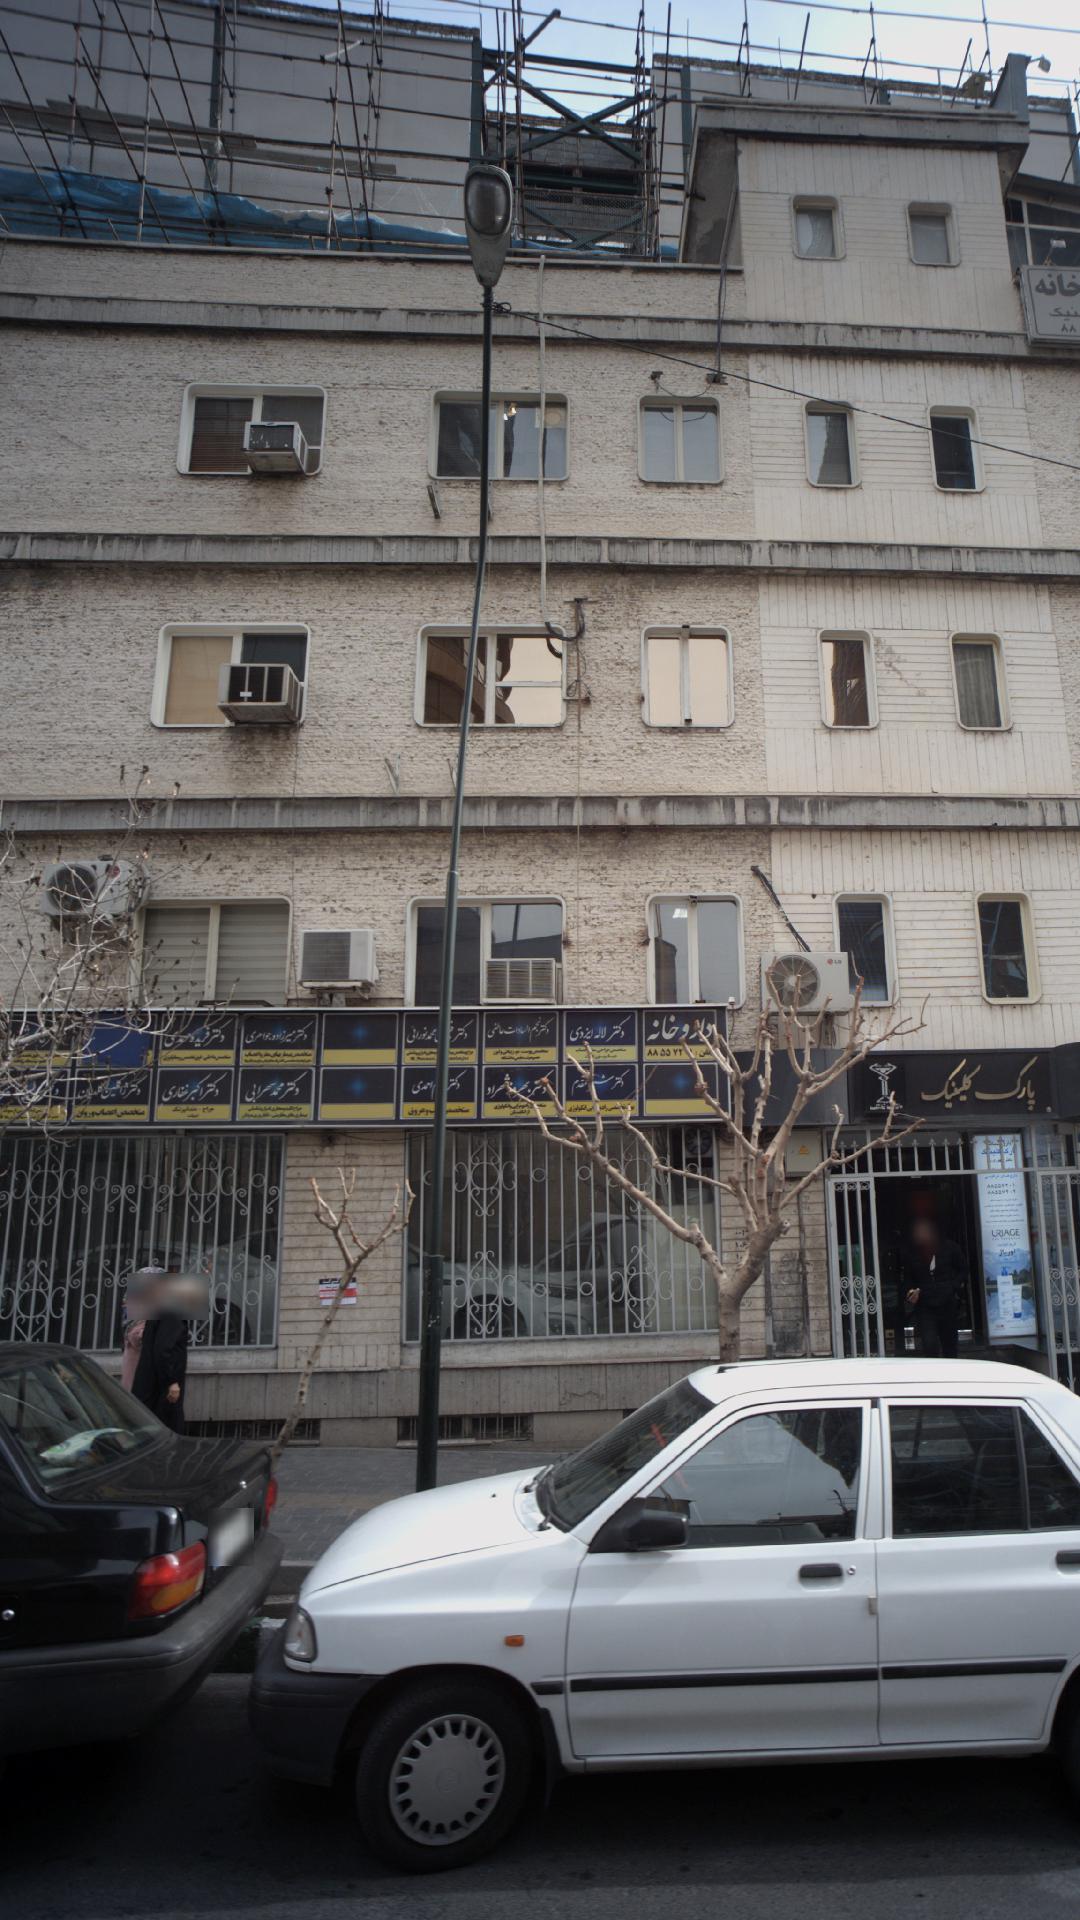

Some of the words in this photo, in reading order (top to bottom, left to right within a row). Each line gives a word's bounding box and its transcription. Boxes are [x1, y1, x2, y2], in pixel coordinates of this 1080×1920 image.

[203, 1018, 233, 1047] دکتر
[292, 1020, 314, 1043] دکتر
[450, 1019, 474, 1043] دکتر
[536, 1017, 554, 1038] دکتر
[569, 1026, 593, 1042] ایزدی
[594, 1025, 607, 1039] لاله
[606, 1015, 632, 1042] دکتر
[121, 1074, 148, 1099] دکتر
[183, 1073, 212, 1102] اکبر
[199, 1072, 228, 1101] دکتر
[278, 1071, 308, 1100] دکتر
[447, 1069, 467, 1091] دکتر
[610, 1069, 631, 1090] دکتر
[921, 1058, 982, 1109] کلینیک
[975, 1056, 1039, 1111] پارک
[162, 1084, 189, 1102] غفاری
[991, 1228, 1021, 1237] URIAGE
